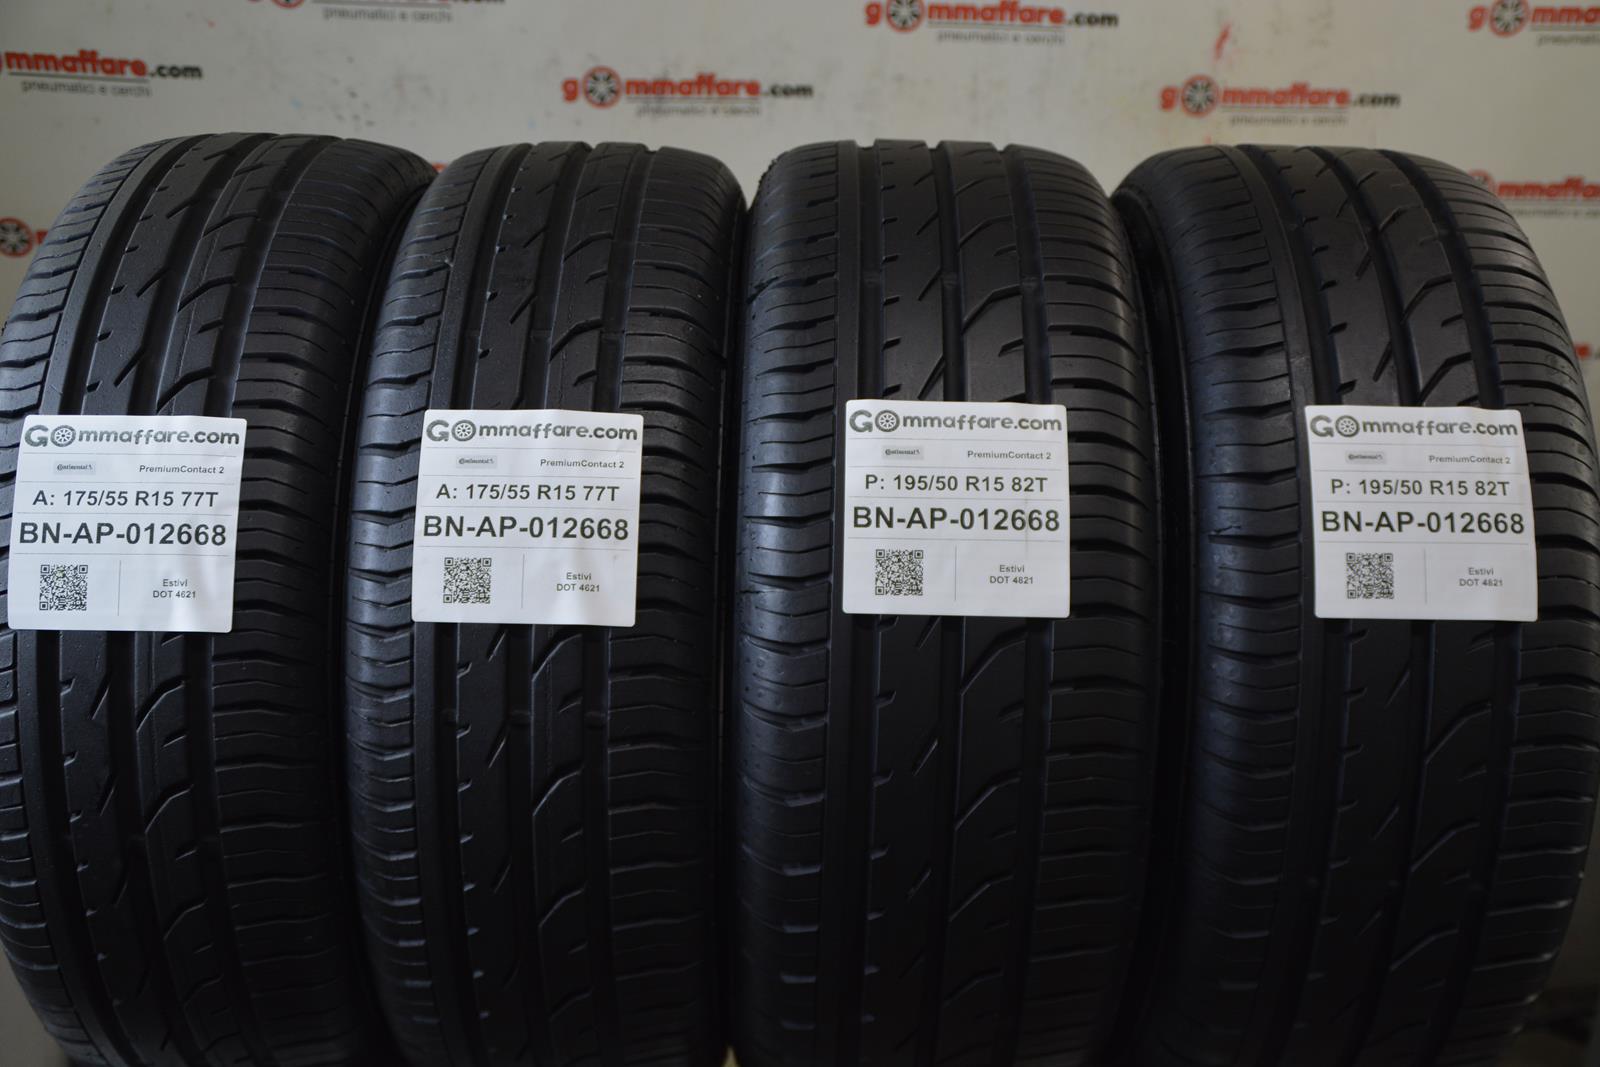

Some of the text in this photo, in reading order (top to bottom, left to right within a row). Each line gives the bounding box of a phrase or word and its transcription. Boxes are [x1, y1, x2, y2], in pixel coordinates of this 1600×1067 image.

[967, 450, 1052, 460] PremiumContact 2
[1429, 455, 1511, 465] PremiumContact 2
[540, 458, 625, 469] PremiumContact 2
[139, 464, 225, 474] PremiumContact 2
[865, 474, 1049, 493] P: 195/50 R15 82T
[1331, 479, 1510, 497] P: 195/50 R15 82T
[436, 484, 620, 502] A: 175/55 R15 77T
[33, 490, 219, 507] A: 175/55 R15 77T
[853, 506, 1060, 532] BN-AP-012668
[1321, 511, 1525, 535] BN-AP-012668
[423, 515, 629, 541] BN-AP-012668
[19, 522, 227, 547] BN-AP-012668
[999, 565, 1025, 573] Estivi
[1468, 567, 1494, 576] Estivi
[566, 572, 592, 581] Estivi
[989, 576, 1010, 584] DOT
[163, 578, 188, 588] Estivi
[1459, 578, 1479, 587] DOT
[556, 583, 600, 593] DOT 4621
[153, 590, 196, 599] DOT 4621
